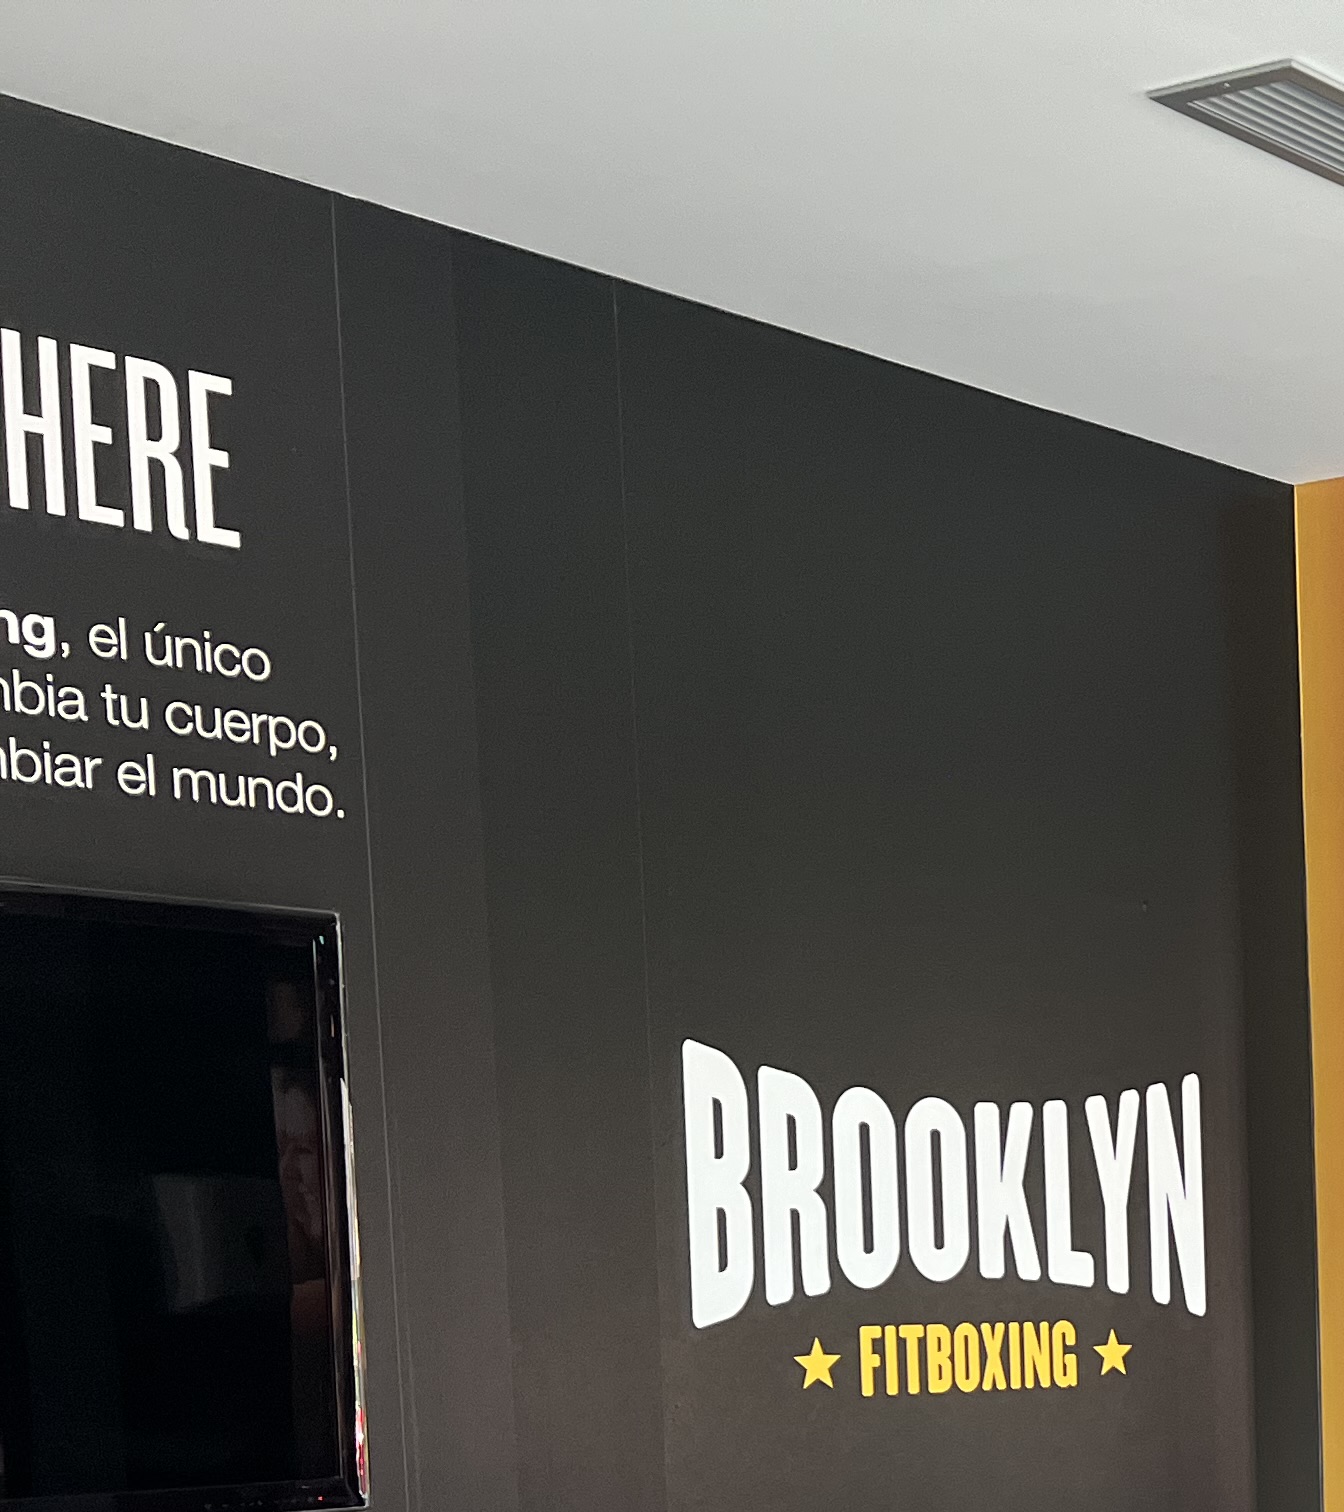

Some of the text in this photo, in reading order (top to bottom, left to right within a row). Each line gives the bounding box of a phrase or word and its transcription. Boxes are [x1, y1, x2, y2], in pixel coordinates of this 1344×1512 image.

[0, 328, 241, 549] HERE
[89, 617, 128, 661] el
[145, 623, 272, 682] único
[0, 669, 338, 762] bia tu cuerpo,
[0, 737, 345, 819] biar el mundo.
[681, 1038, 1206, 1329] BROOKLYN
[859, 1319, 1078, 1397] FITBOXING
